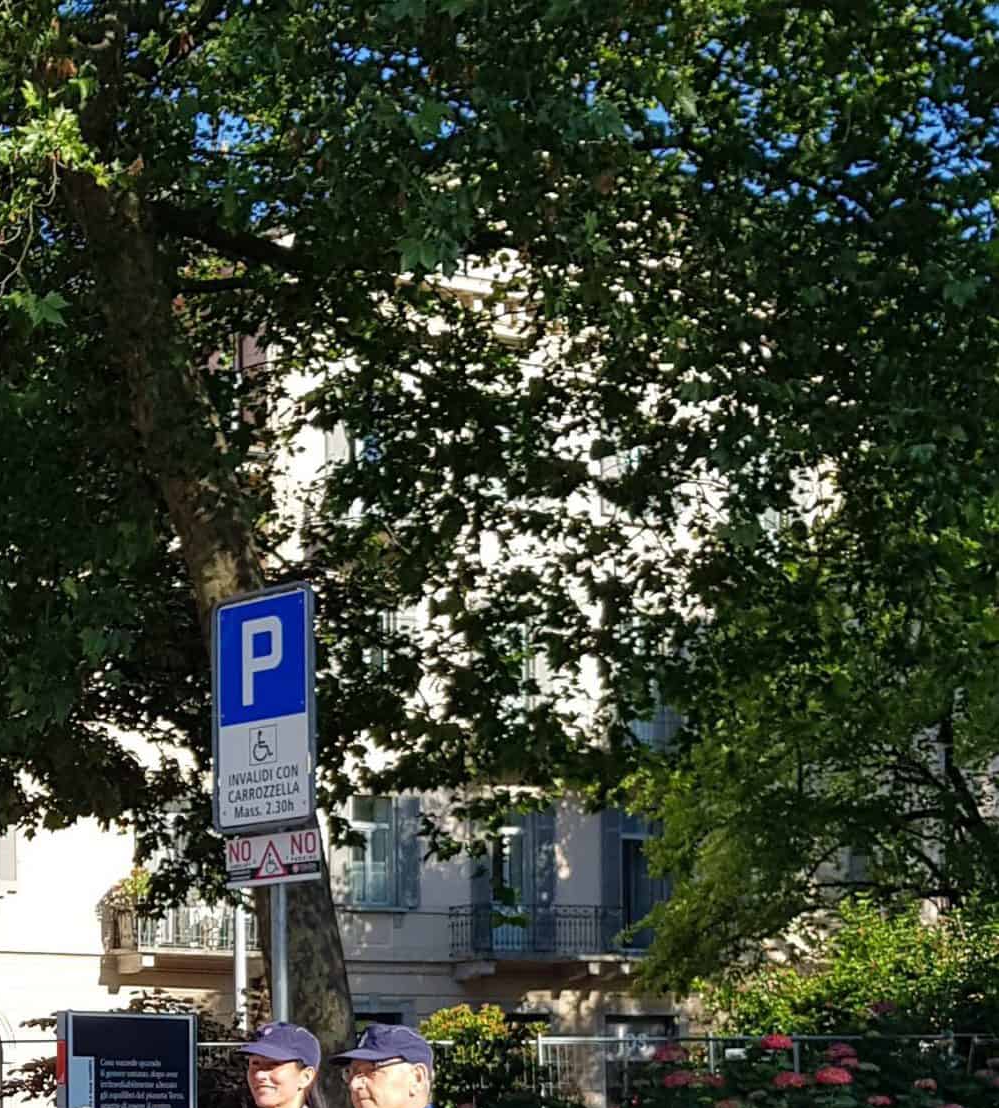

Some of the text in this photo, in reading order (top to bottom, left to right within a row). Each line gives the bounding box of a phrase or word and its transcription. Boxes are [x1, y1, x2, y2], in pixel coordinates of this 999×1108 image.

[241, 615, 284, 707] P
[228, 764, 300, 787] INVALIDI CON
[227, 781, 301, 804] CARROZZELLA
[233, 800, 295, 820] Mass. 2.30h
[227, 840, 252, 864] NO
[289, 831, 317, 855] NO
